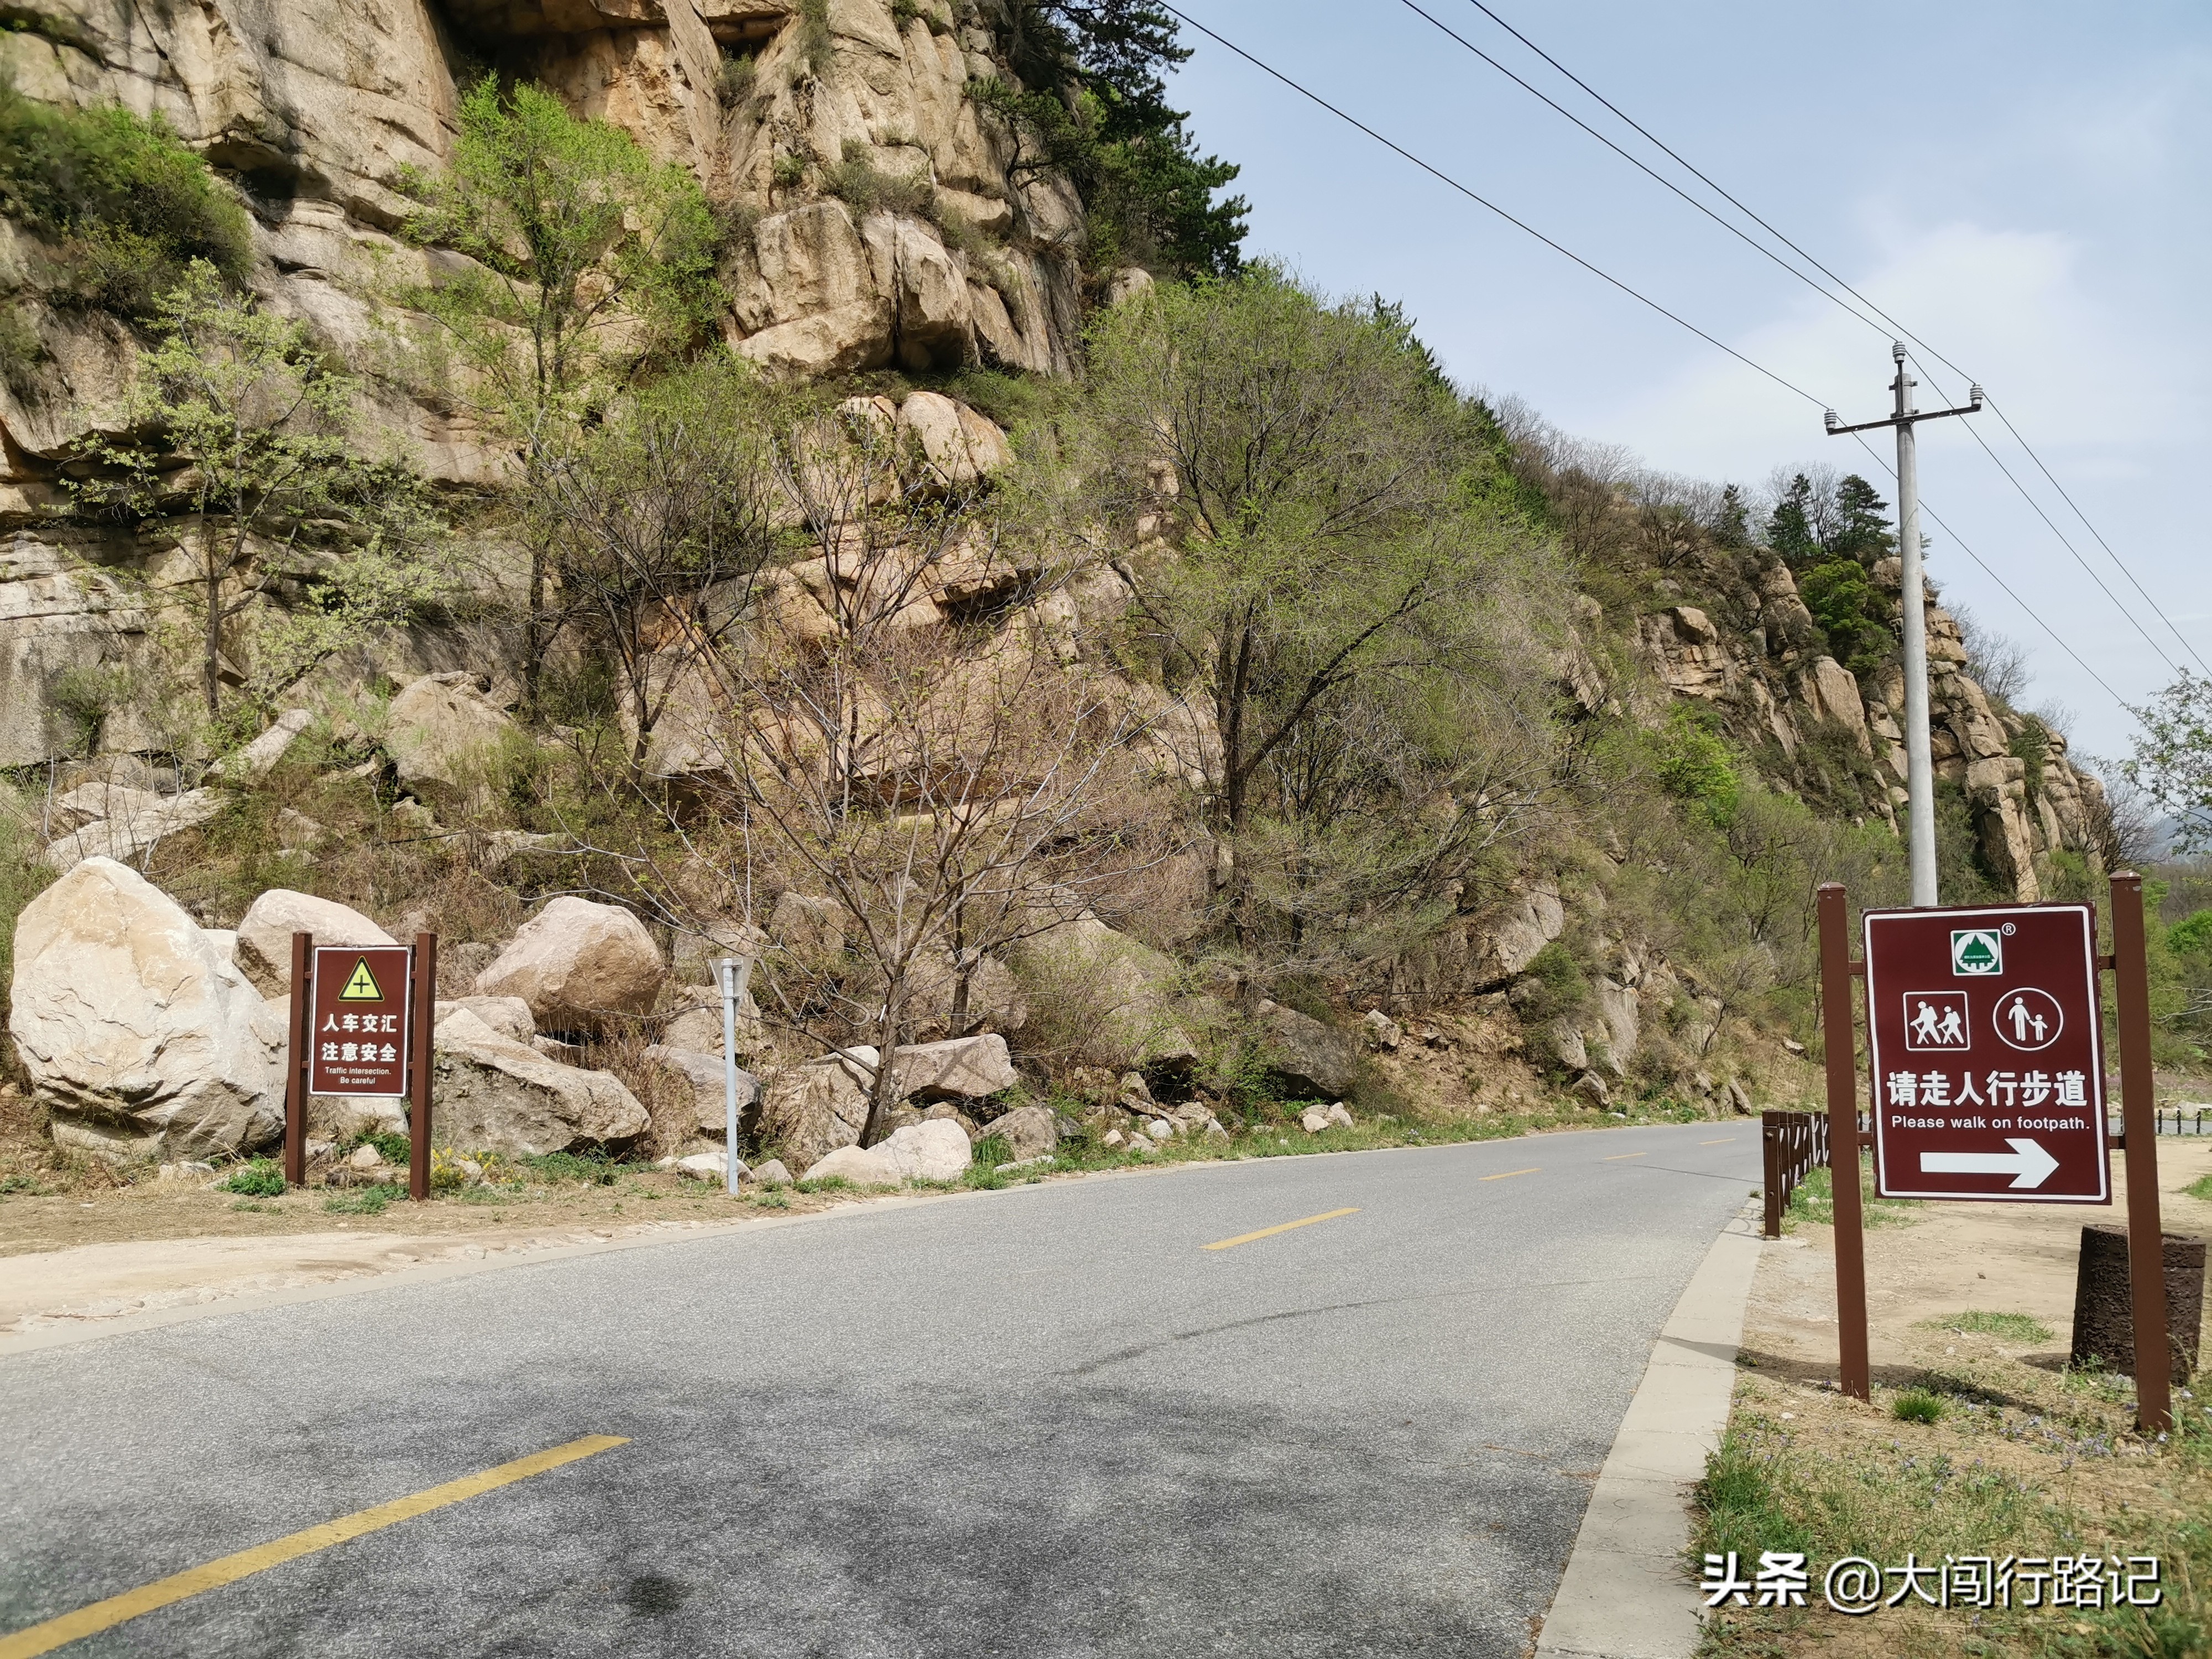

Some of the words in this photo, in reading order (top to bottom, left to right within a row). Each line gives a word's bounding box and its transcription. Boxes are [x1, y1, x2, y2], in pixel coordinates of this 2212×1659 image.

[322, 1013, 397, 1032] 人车交汇
[322, 1042, 397, 1061] 注意安全
[1886, 1070, 2088, 1107] 请走人行步道
[1892, 1115, 1944, 1128] Please
[1950, 1116, 1986, 1129] walk
[1992, 1119, 2011, 1129] on
[2017, 1116, 2090, 1131] footpath.
